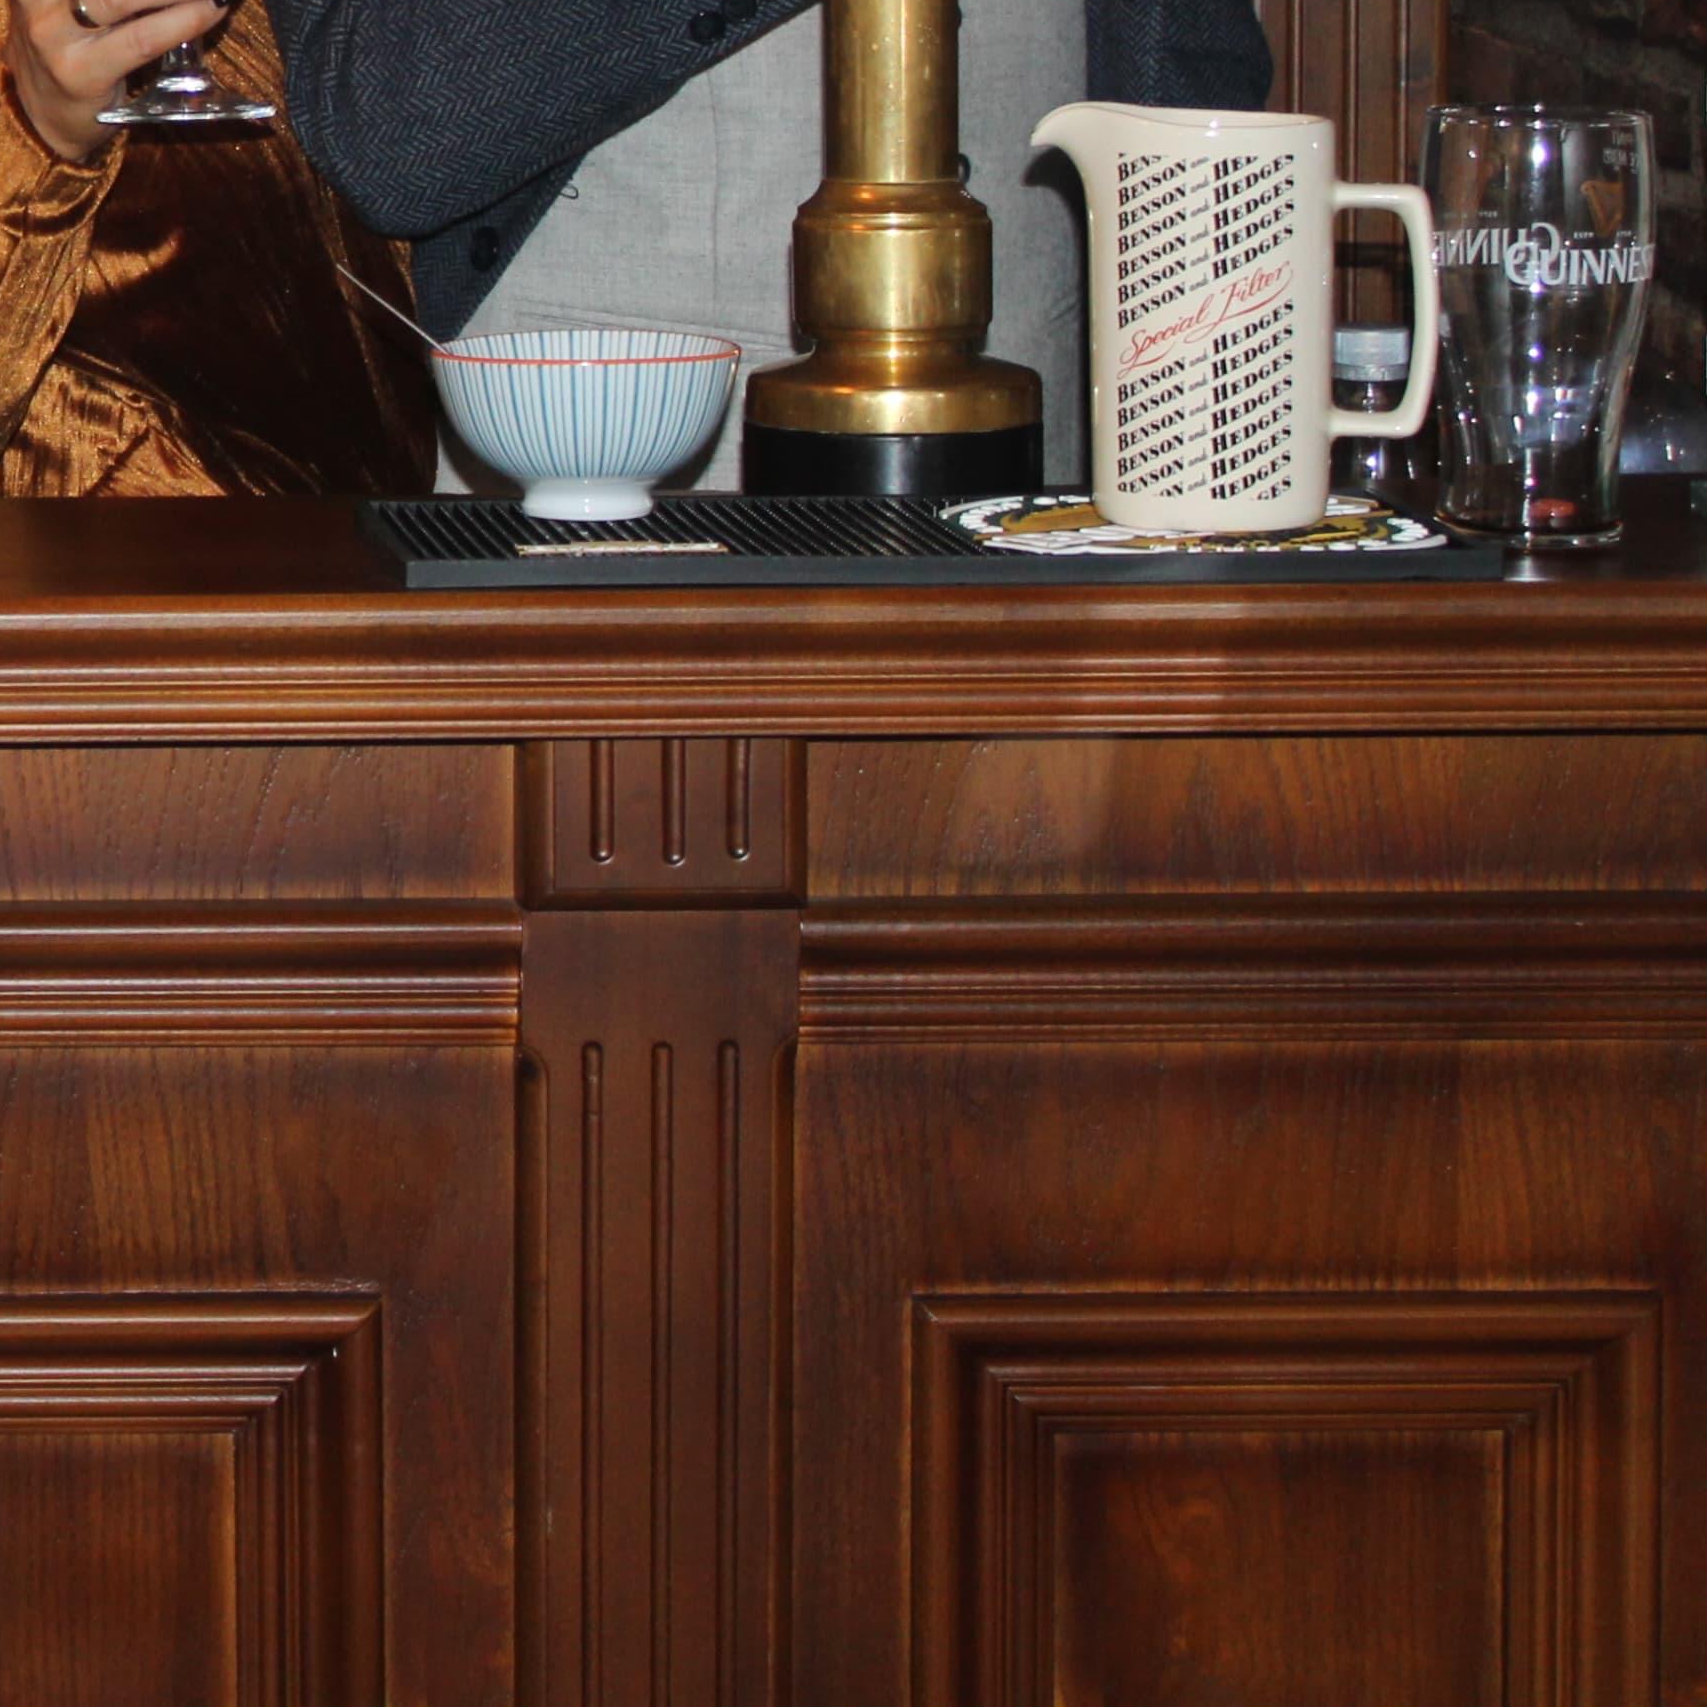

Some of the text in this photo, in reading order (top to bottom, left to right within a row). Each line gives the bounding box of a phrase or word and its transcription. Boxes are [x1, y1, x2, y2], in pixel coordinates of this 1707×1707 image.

[1117, 155, 1163, 183] BENS
[1117, 159, 1187, 207] BENSON
[1117, 183, 1187, 232] BENSON
[1189, 174, 1210, 194] and
[1117, 154, 1295, 256] BENSON and HEDGES
[1117, 174, 1295, 281] BENSON and HEDGES
[1117, 198, 1295, 306] BENSON and HEDGES
[1117, 224, 1294, 330] BENSON and HEDGES
[1504, 242, 1656, 285] GUINNES
[1117, 261, 1294, 380] Special Filter
[1117, 298, 1294, 404] BENSON and HEDGES
[1117, 324, 1294, 429] BENSON and HEDGES
[1117, 349, 1294, 453] BENSON and HEDGES
[1117, 374, 1292, 478] BENSON and HEDGES
[1188, 447, 1208, 467] and
[1211, 400, 1292, 456] HEDGES
[1188, 425, 1292, 492] and HEDGES
[1211, 450, 1292, 501] HEDGES
